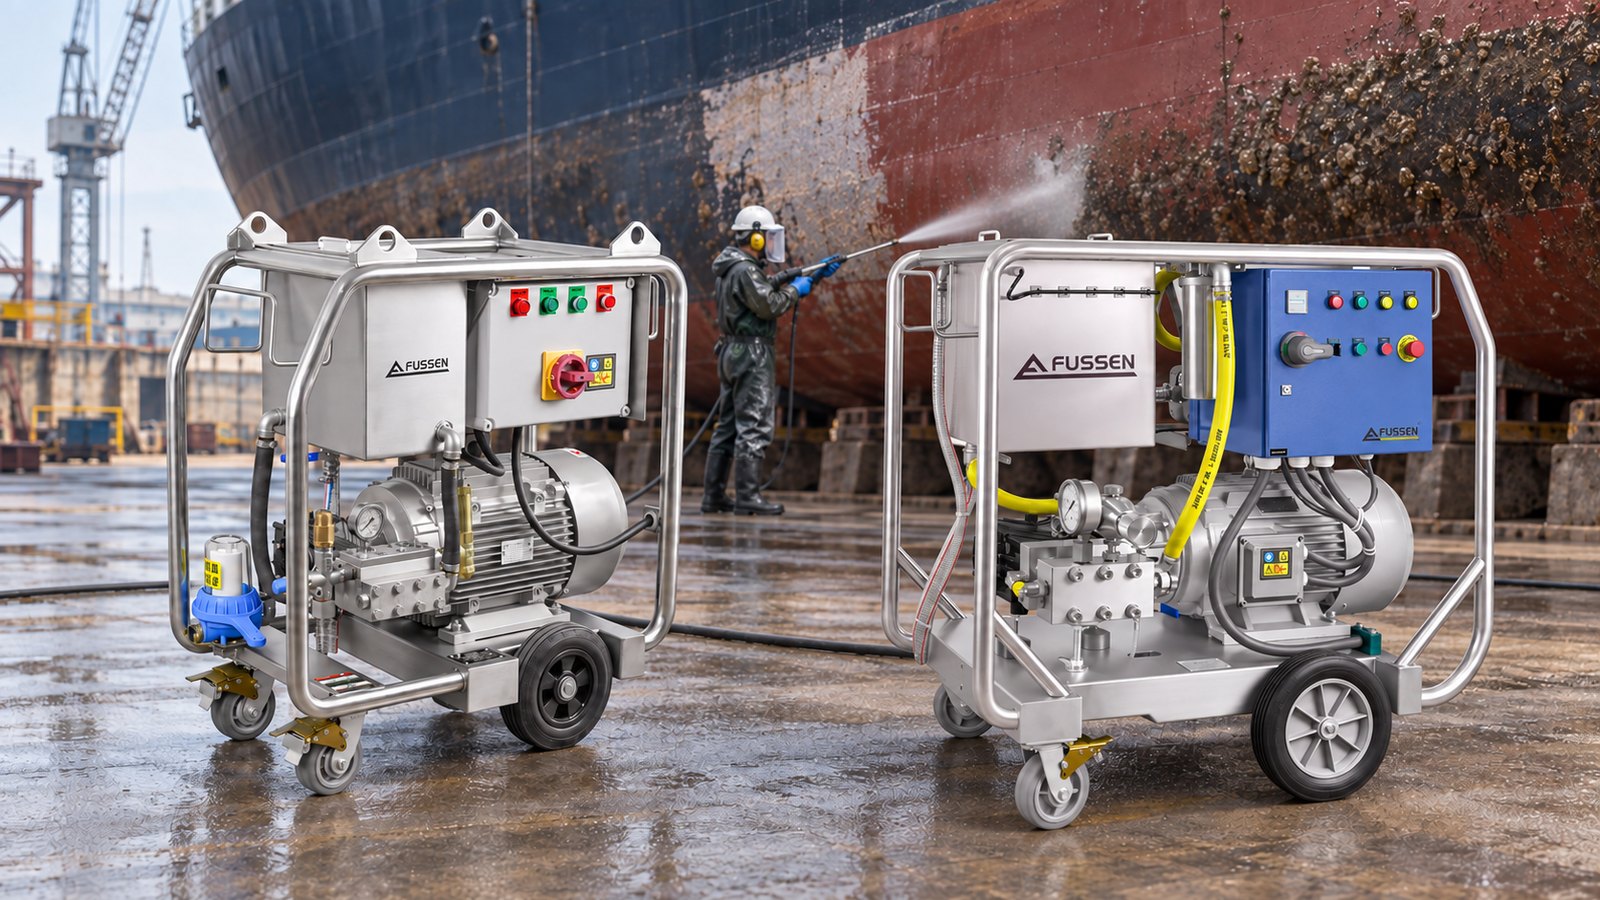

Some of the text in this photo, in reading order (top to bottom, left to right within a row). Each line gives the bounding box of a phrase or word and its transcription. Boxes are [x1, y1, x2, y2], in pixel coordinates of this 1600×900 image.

[405, 357, 449, 371] FUSSEN
[1052, 354, 1135, 371] FUSSEN
[1379, 426, 1418, 436] FUSSEN
